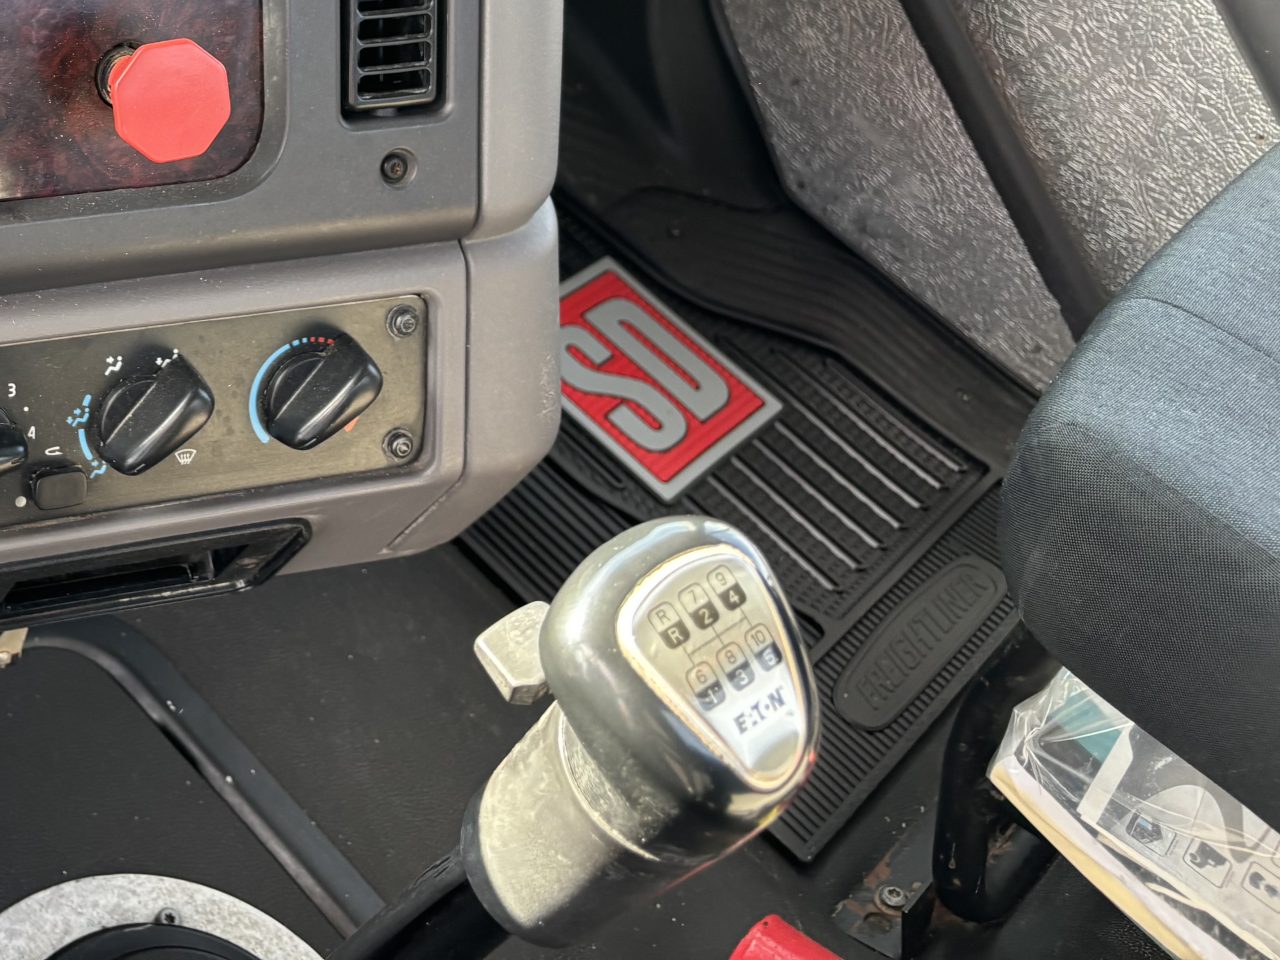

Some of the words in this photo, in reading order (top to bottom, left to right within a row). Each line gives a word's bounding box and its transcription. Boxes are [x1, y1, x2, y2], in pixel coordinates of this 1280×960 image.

[7, 382, 17, 398] 3
[26, 425, 36, 440] 4
[715, 571, 728, 587] 9
[687, 590, 699, 605] 7
[727, 591, 740, 605] 4
[654, 609, 671, 626] R
[699, 609, 713, 625] 2
[667, 628, 684, 645] R
[749, 630, 767, 647] 10
[724, 650, 738, 664] 8
[694, 669, 708, 684] 6
[736, 670, 750, 686] 3
